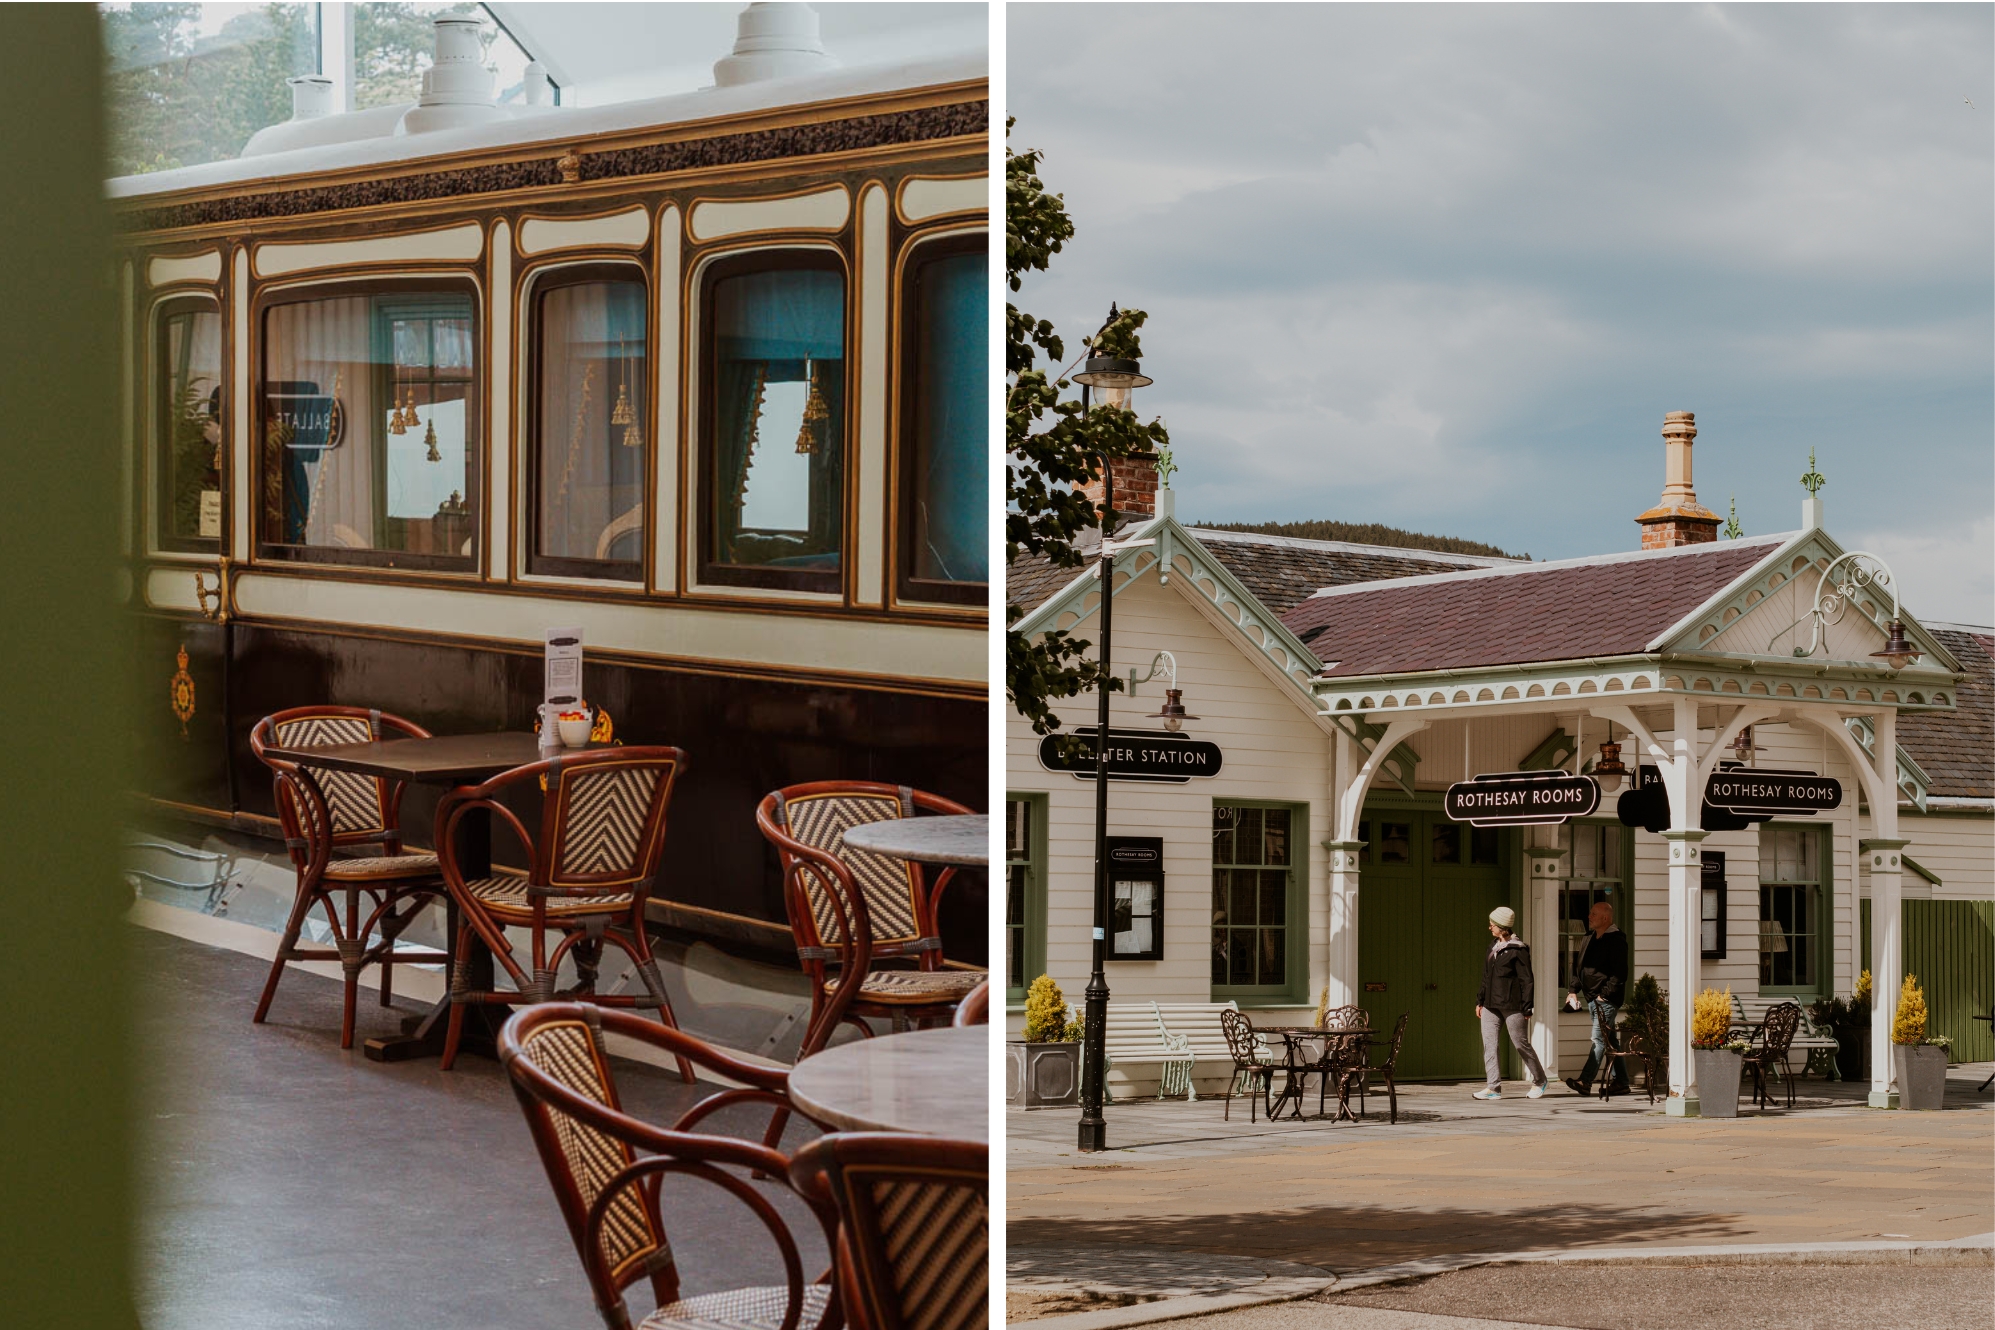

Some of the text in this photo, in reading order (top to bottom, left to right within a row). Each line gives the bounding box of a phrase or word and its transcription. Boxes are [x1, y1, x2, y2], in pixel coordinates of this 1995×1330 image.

[1141, 749, 1207, 765] STATION
[1457, 788, 1583, 807] ROTHESAY ROOMS
[1713, 783, 1834, 801] ROTHESAY ROOMS
